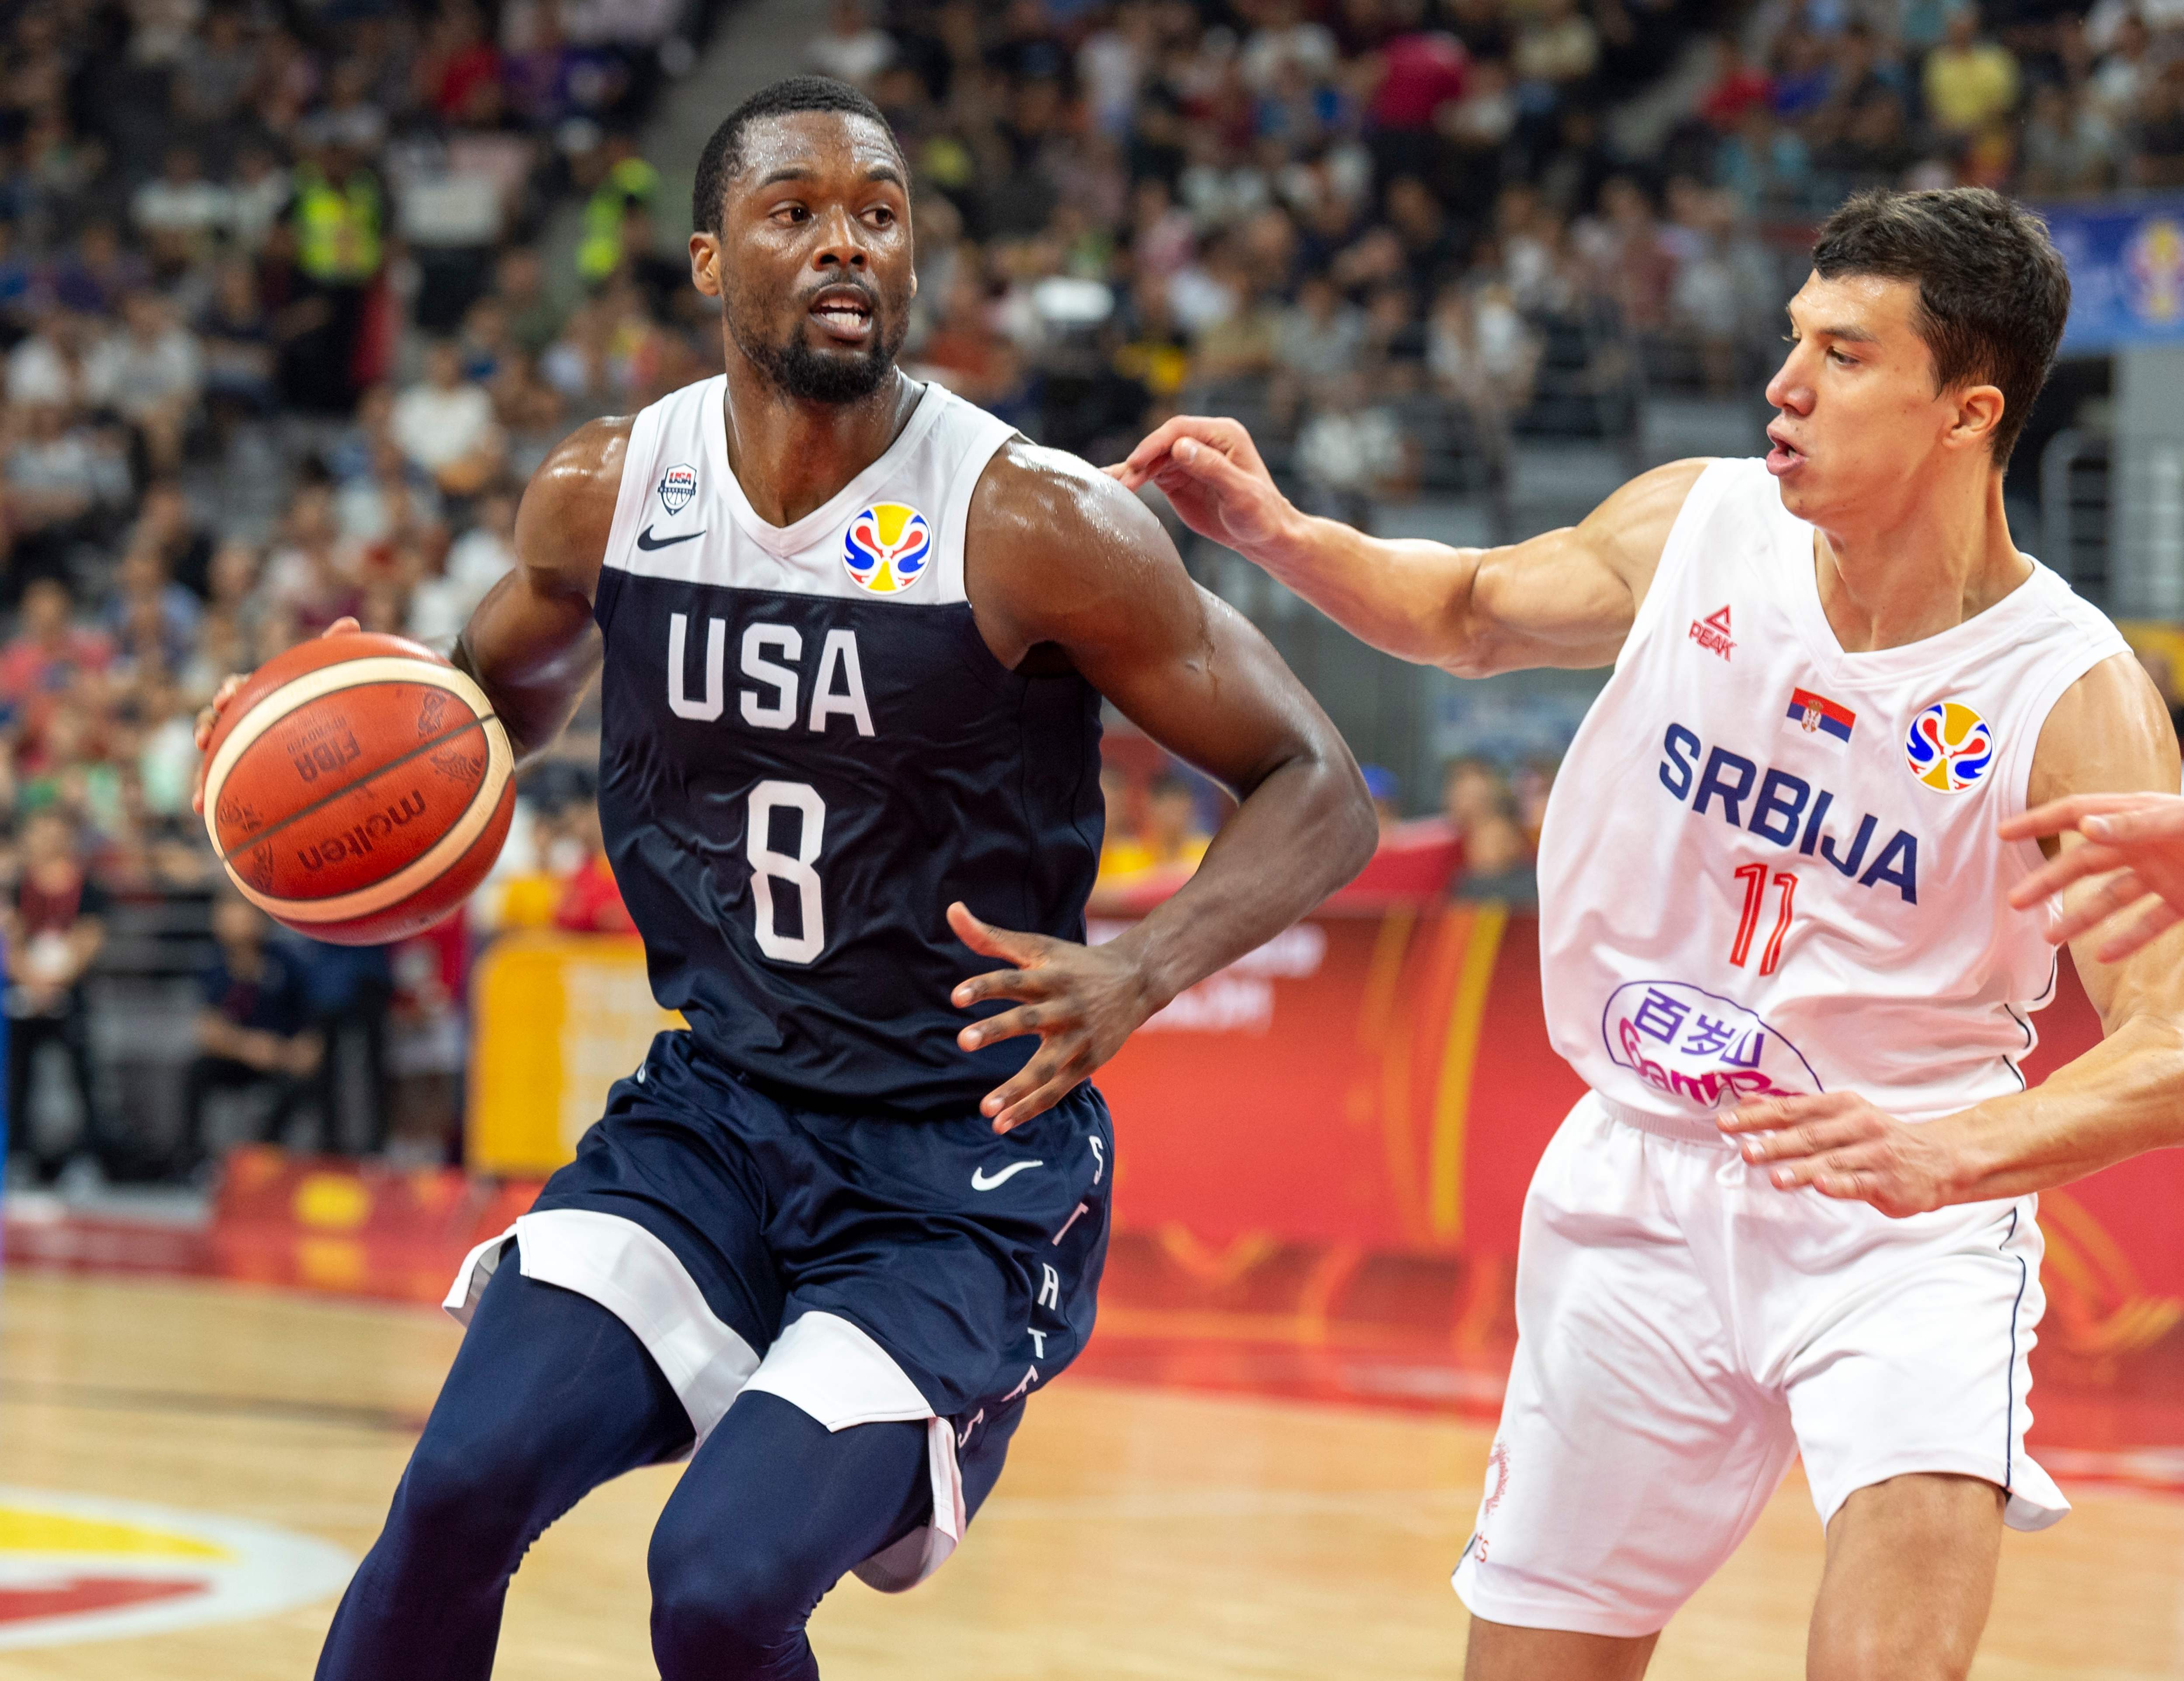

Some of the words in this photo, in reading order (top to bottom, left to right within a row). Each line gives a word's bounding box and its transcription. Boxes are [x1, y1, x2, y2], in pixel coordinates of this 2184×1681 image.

[668, 472, 691, 485] USA
[668, 613, 876, 737] USA
[1689, 619, 1737, 663] PEAK
[294, 730, 361, 782] FIBA
[297, 789, 426, 870] molten
[1659, 722, 1918, 905] SRBIJA
[747, 780, 826, 964] 8
[1729, 863, 1798, 977] 11
[1634, 987, 1765, 1068] 百岁山
